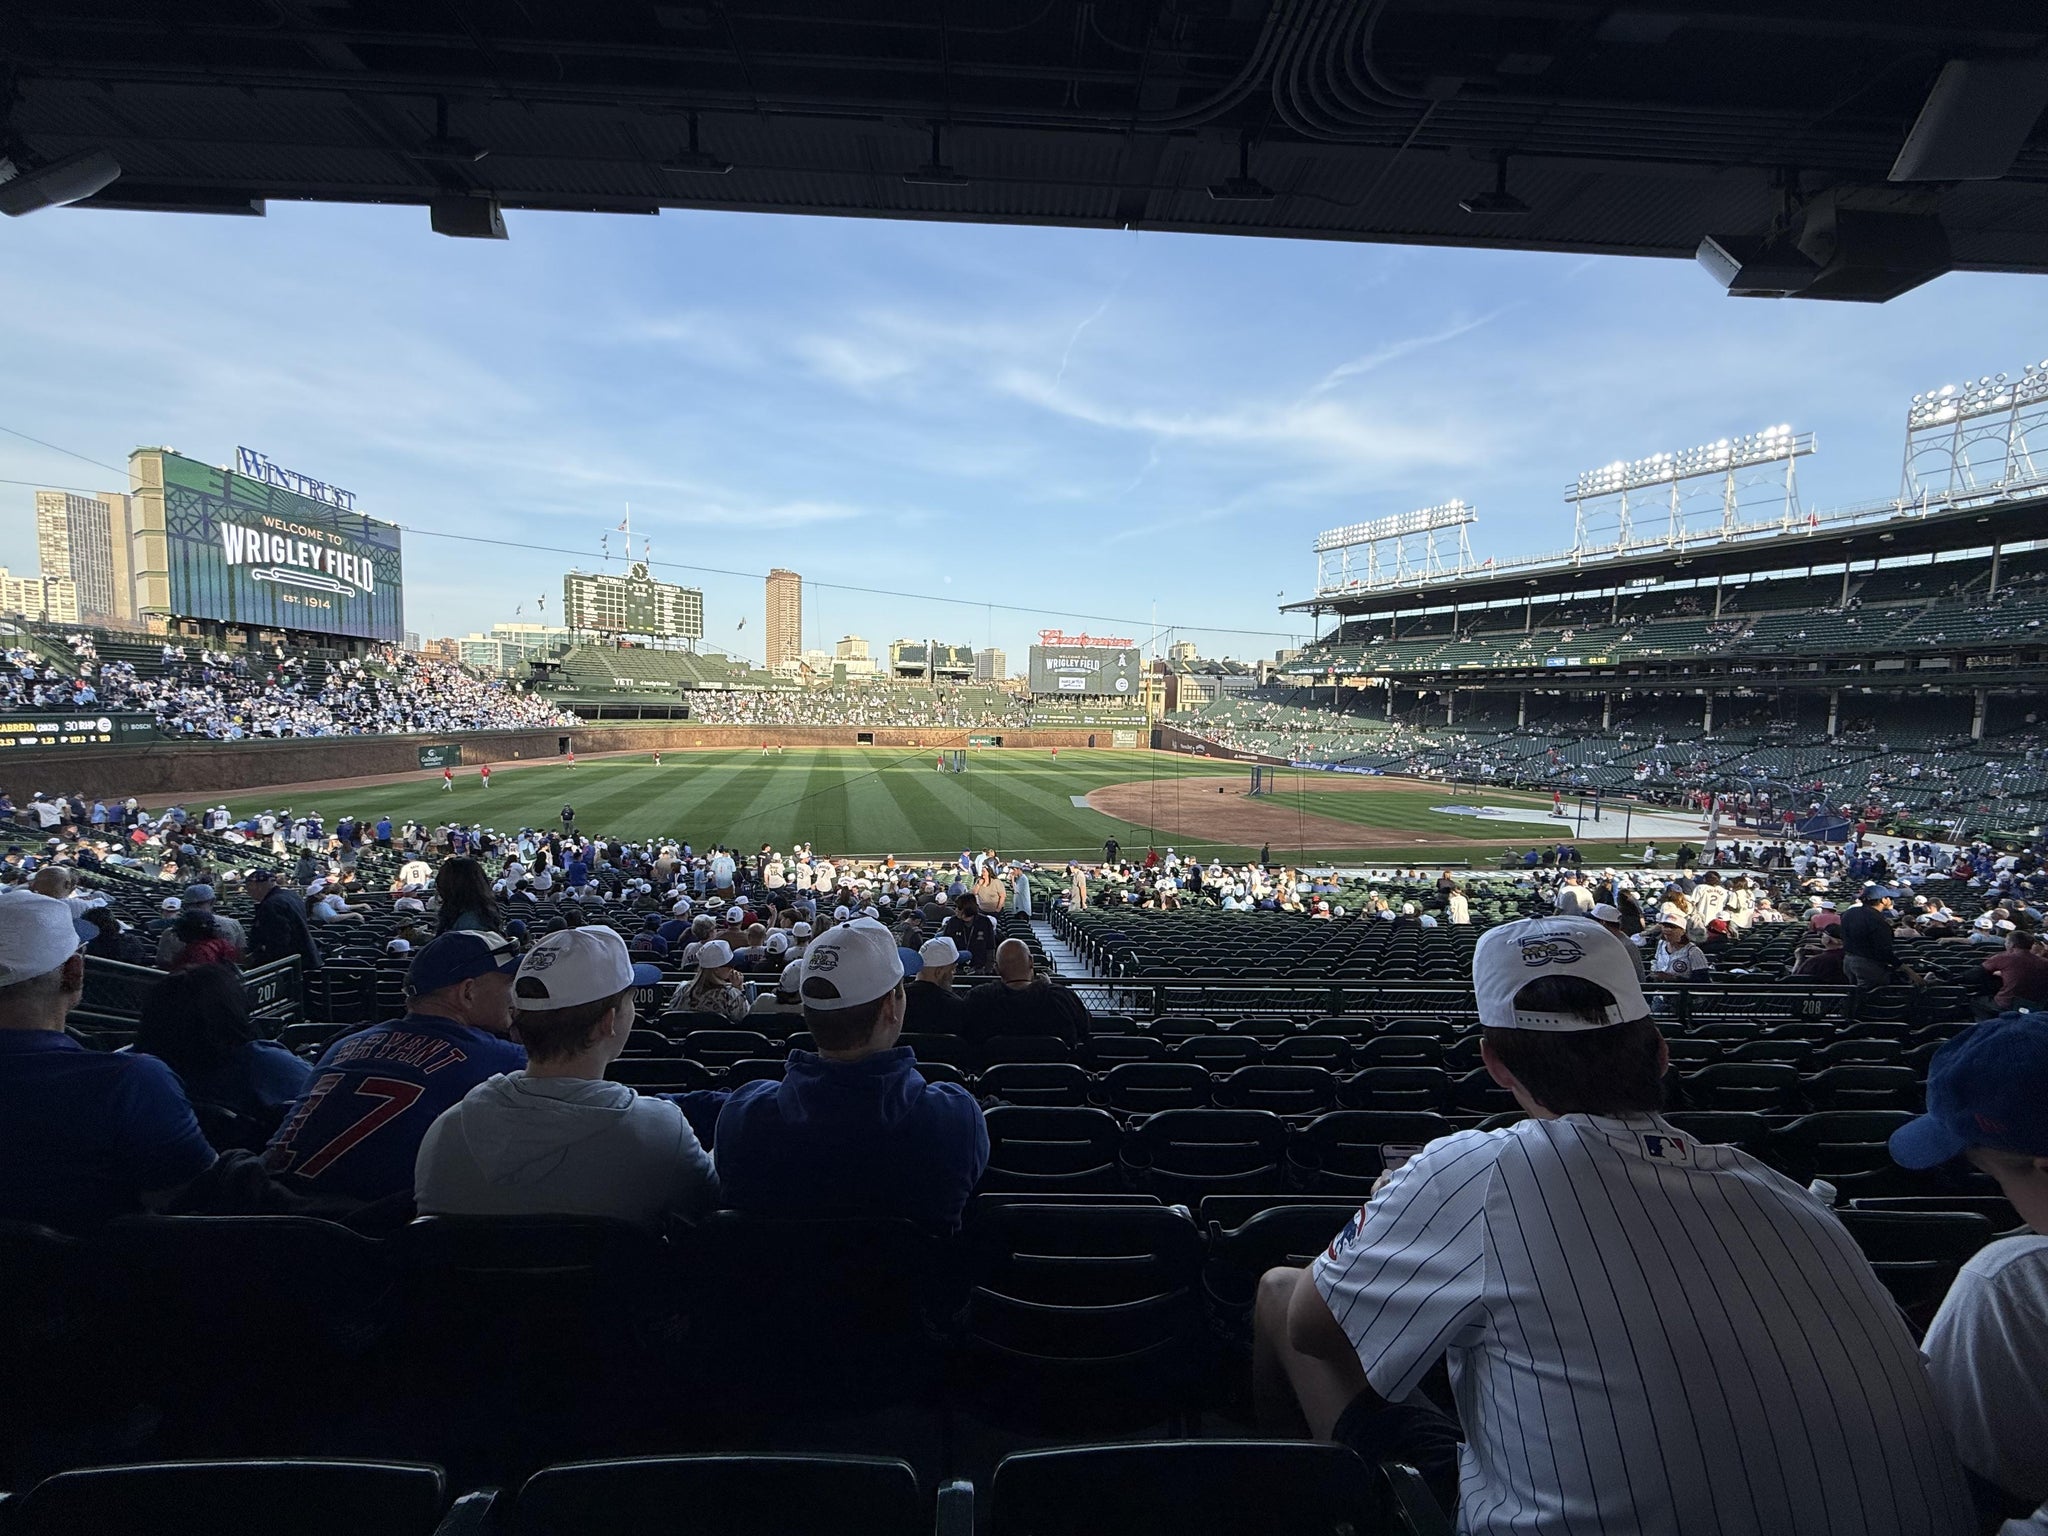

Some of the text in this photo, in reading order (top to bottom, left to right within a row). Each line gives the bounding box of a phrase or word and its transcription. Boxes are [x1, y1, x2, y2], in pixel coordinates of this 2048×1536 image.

[236, 445, 356, 511] WINTRUST
[262, 515, 342, 546] WELCOME TO
[221, 522, 373, 593] WRIGLEY FIELD
[283, 594, 331, 609] EST. 1914
[1045, 658, 1100, 670] WRIGLEY FIELD
[613, 678, 633, 686] YETI
[65, 721, 78, 731] 30
[79, 720, 96, 730] RHP
[412, 870, 419, 878] 8
[1710, 895, 1718, 906] 2
[257, 981, 277, 1003] 207
[633, 988, 653, 1003] 208
[1802, 1000, 1821, 1015] 208
[330, 1031, 468, 1075] BRYANT
